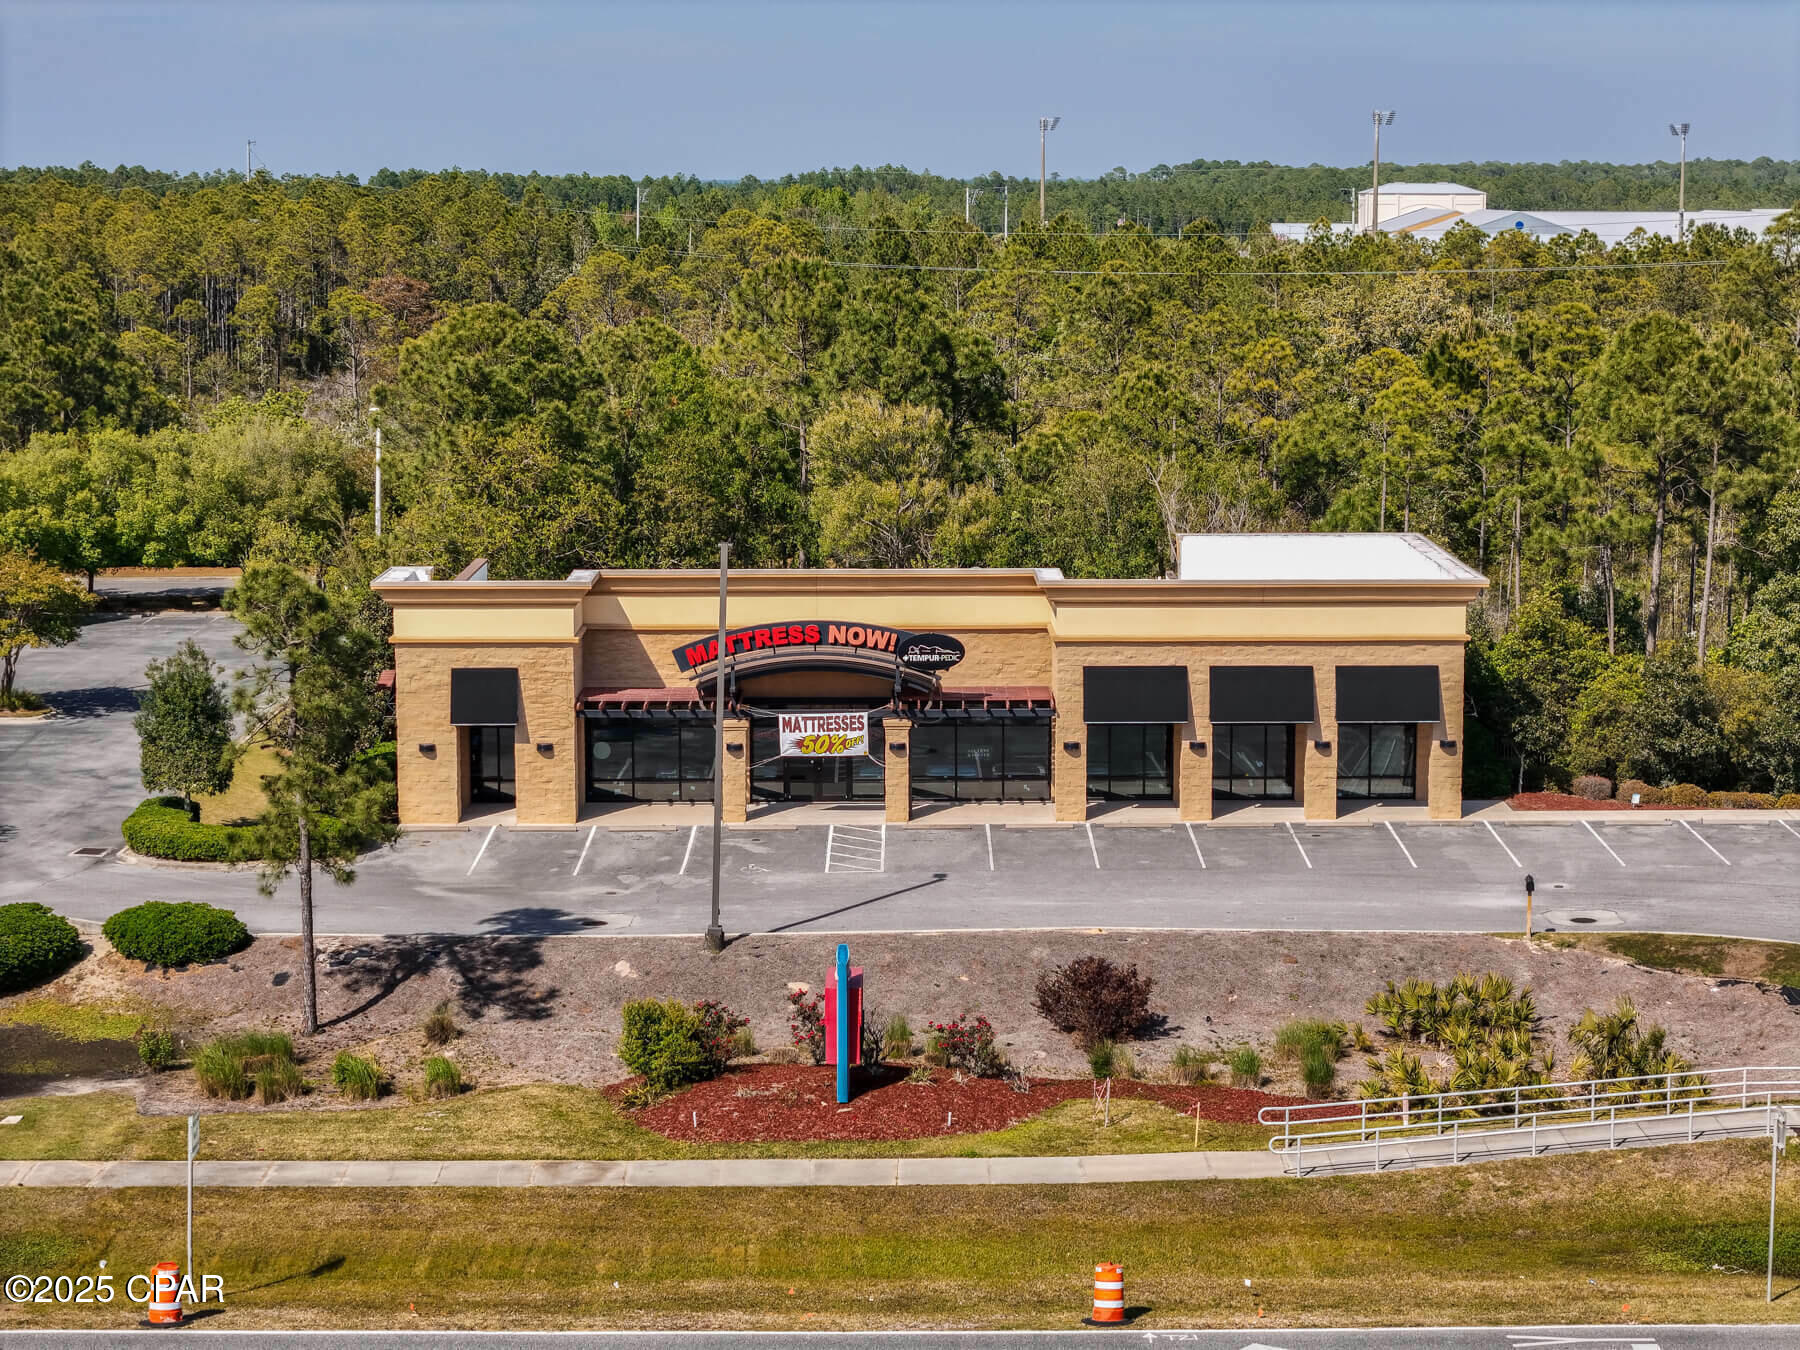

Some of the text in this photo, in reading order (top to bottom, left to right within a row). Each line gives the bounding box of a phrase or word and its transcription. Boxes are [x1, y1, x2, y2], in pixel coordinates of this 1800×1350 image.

[685, 624, 898, 667] MATTRESS NOW!
[782, 715, 865, 733] MATTRESSES
[801, 734, 865, 754] 50% OFF!
